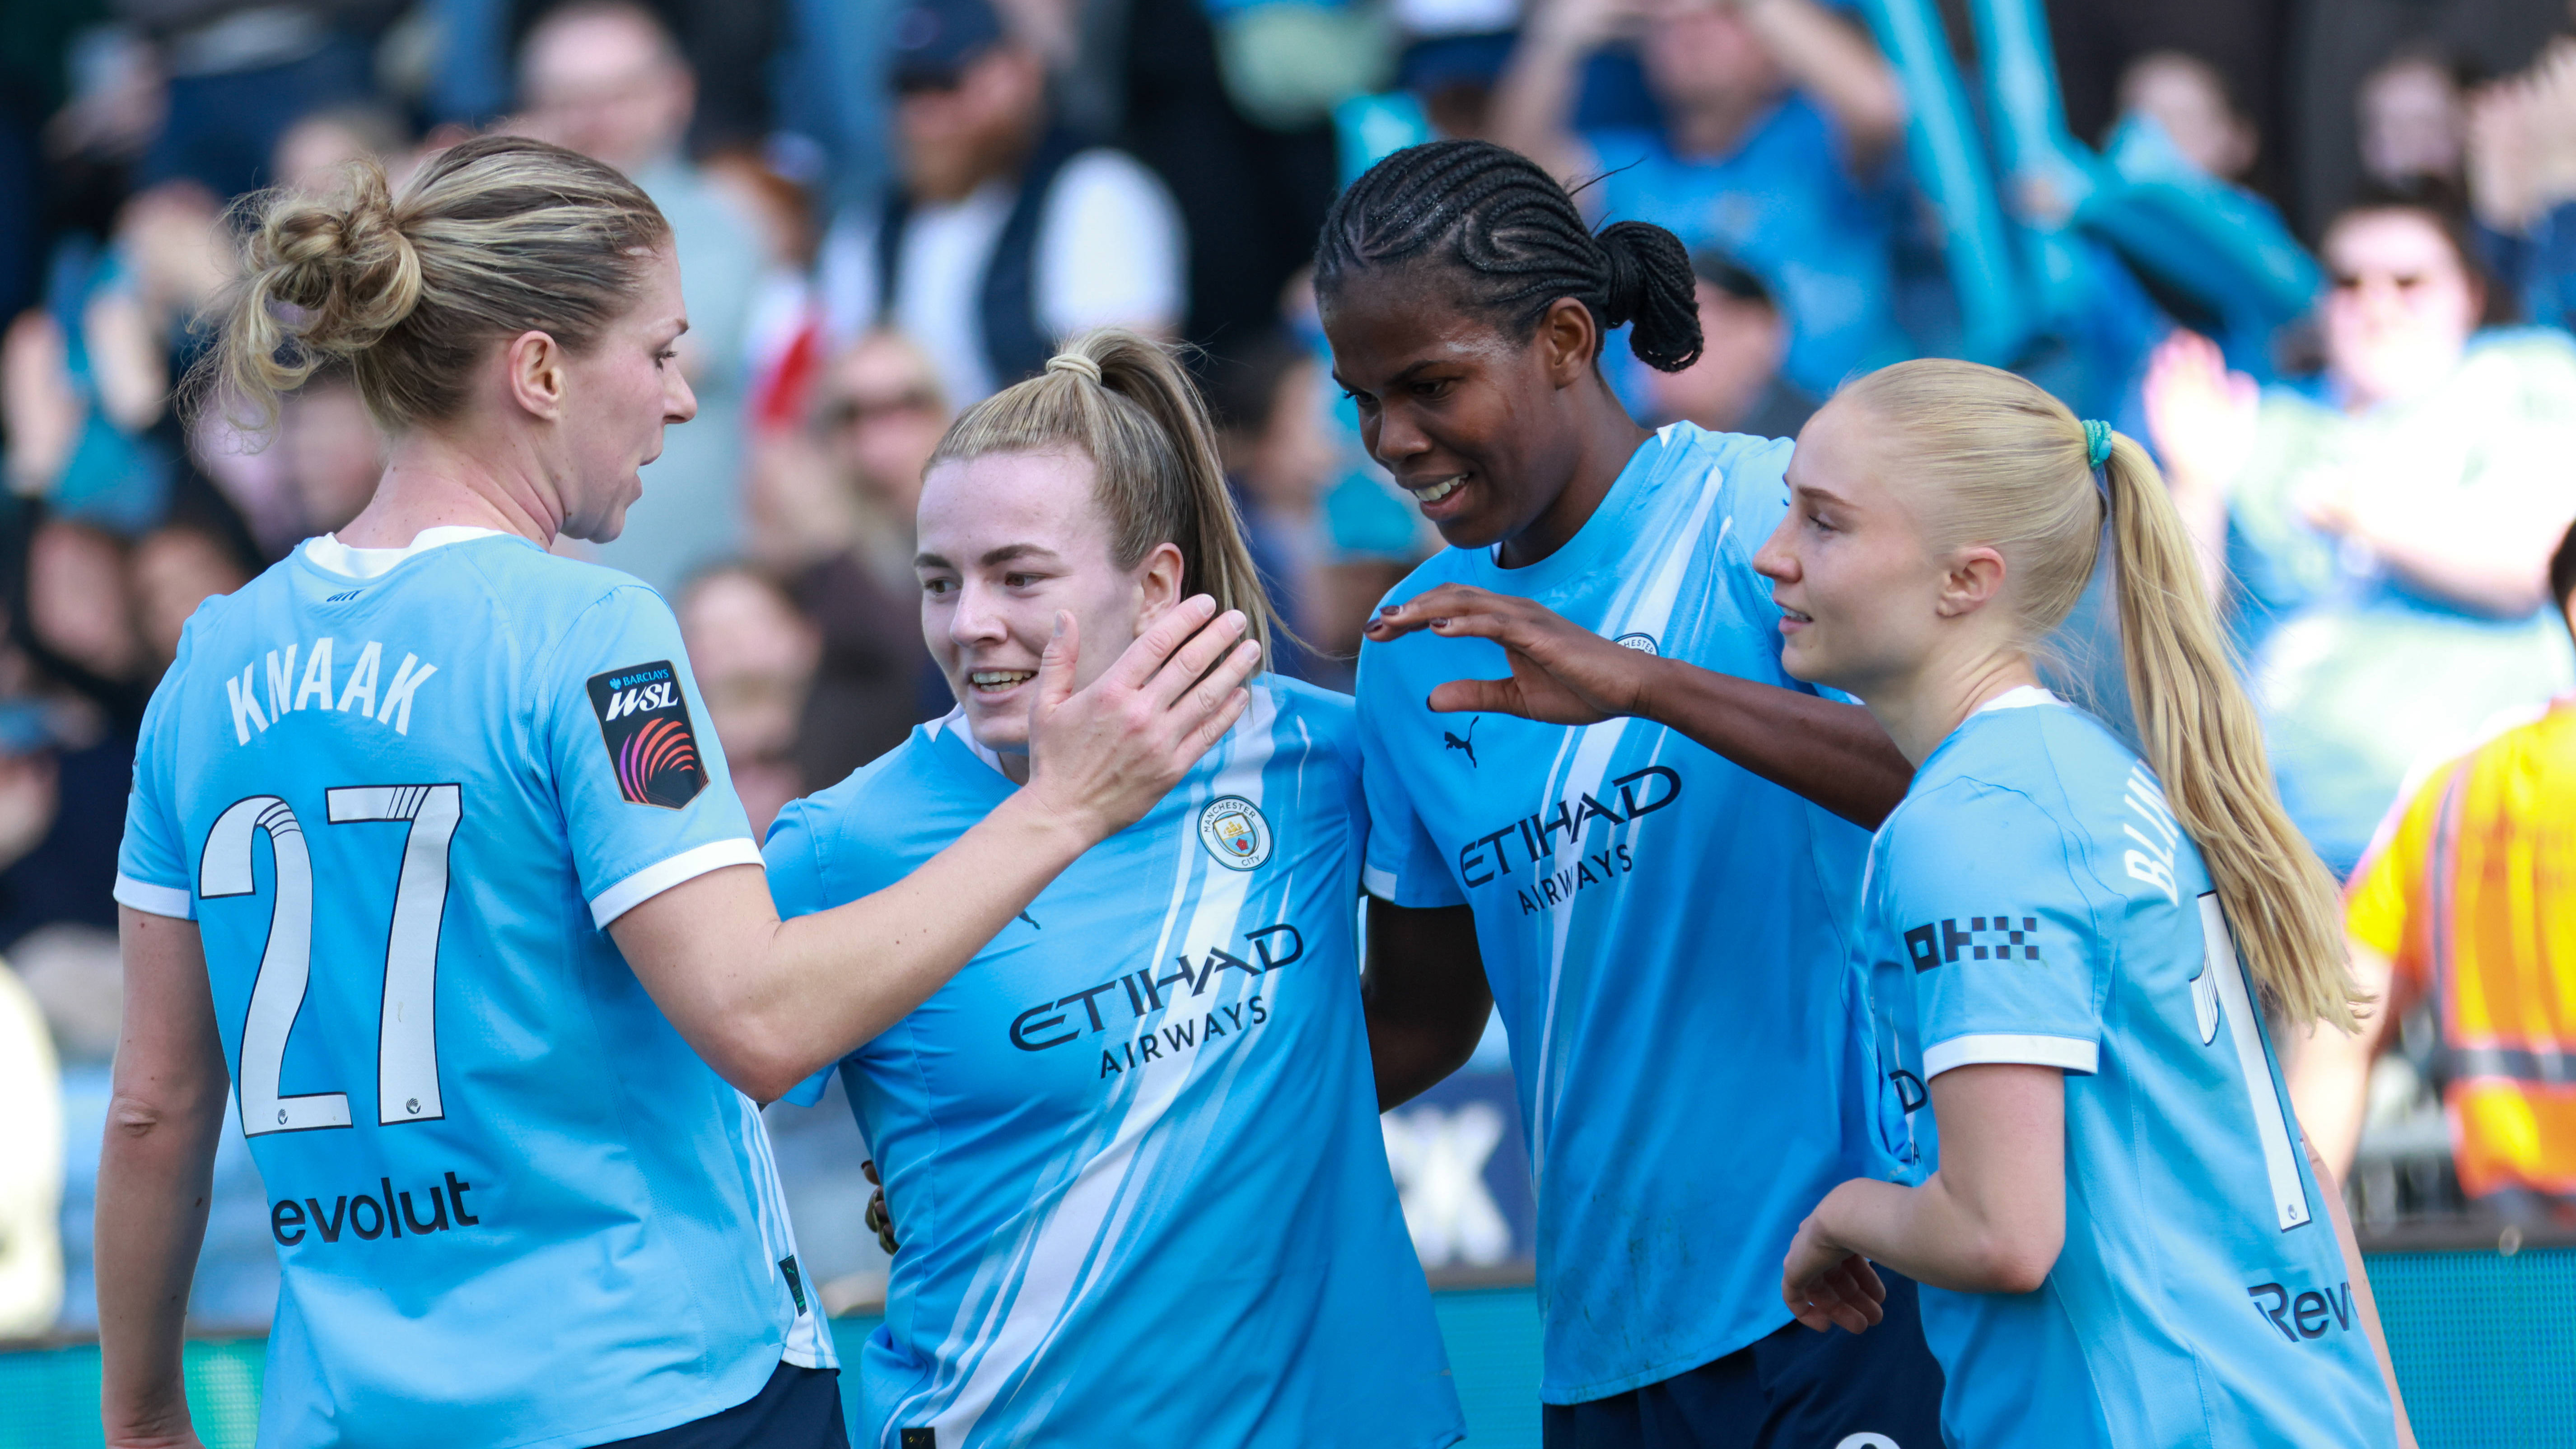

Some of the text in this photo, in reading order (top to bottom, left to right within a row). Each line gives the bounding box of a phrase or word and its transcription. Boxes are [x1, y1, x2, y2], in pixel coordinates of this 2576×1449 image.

[622, 669, 669, 686] BARCLAYS
[1624, 639, 1654, 654] HESTER
[226, 636, 438, 746] KNAAK
[606, 681, 678, 722] WSL
[1204, 801, 1256, 833] MANCHESTER
[1459, 765, 1682, 889] ETIHAD
[2123, 758, 2179, 907] BLIN
[1241, 855, 1260, 867] CITY
[1517, 844, 1633, 916] AIRWAYS
[199, 783, 463, 1139] 27
[1904, 916, 2040, 975] OKX
[1009, 923, 1304, 1052] ETIHAD
[1100, 995, 1267, 1080] AIRWAYS
[2189, 888, 2312, 1234] 1
[271, 1171, 479, 1247] evolut
[2247, 1281, 2359, 1343] Rev
